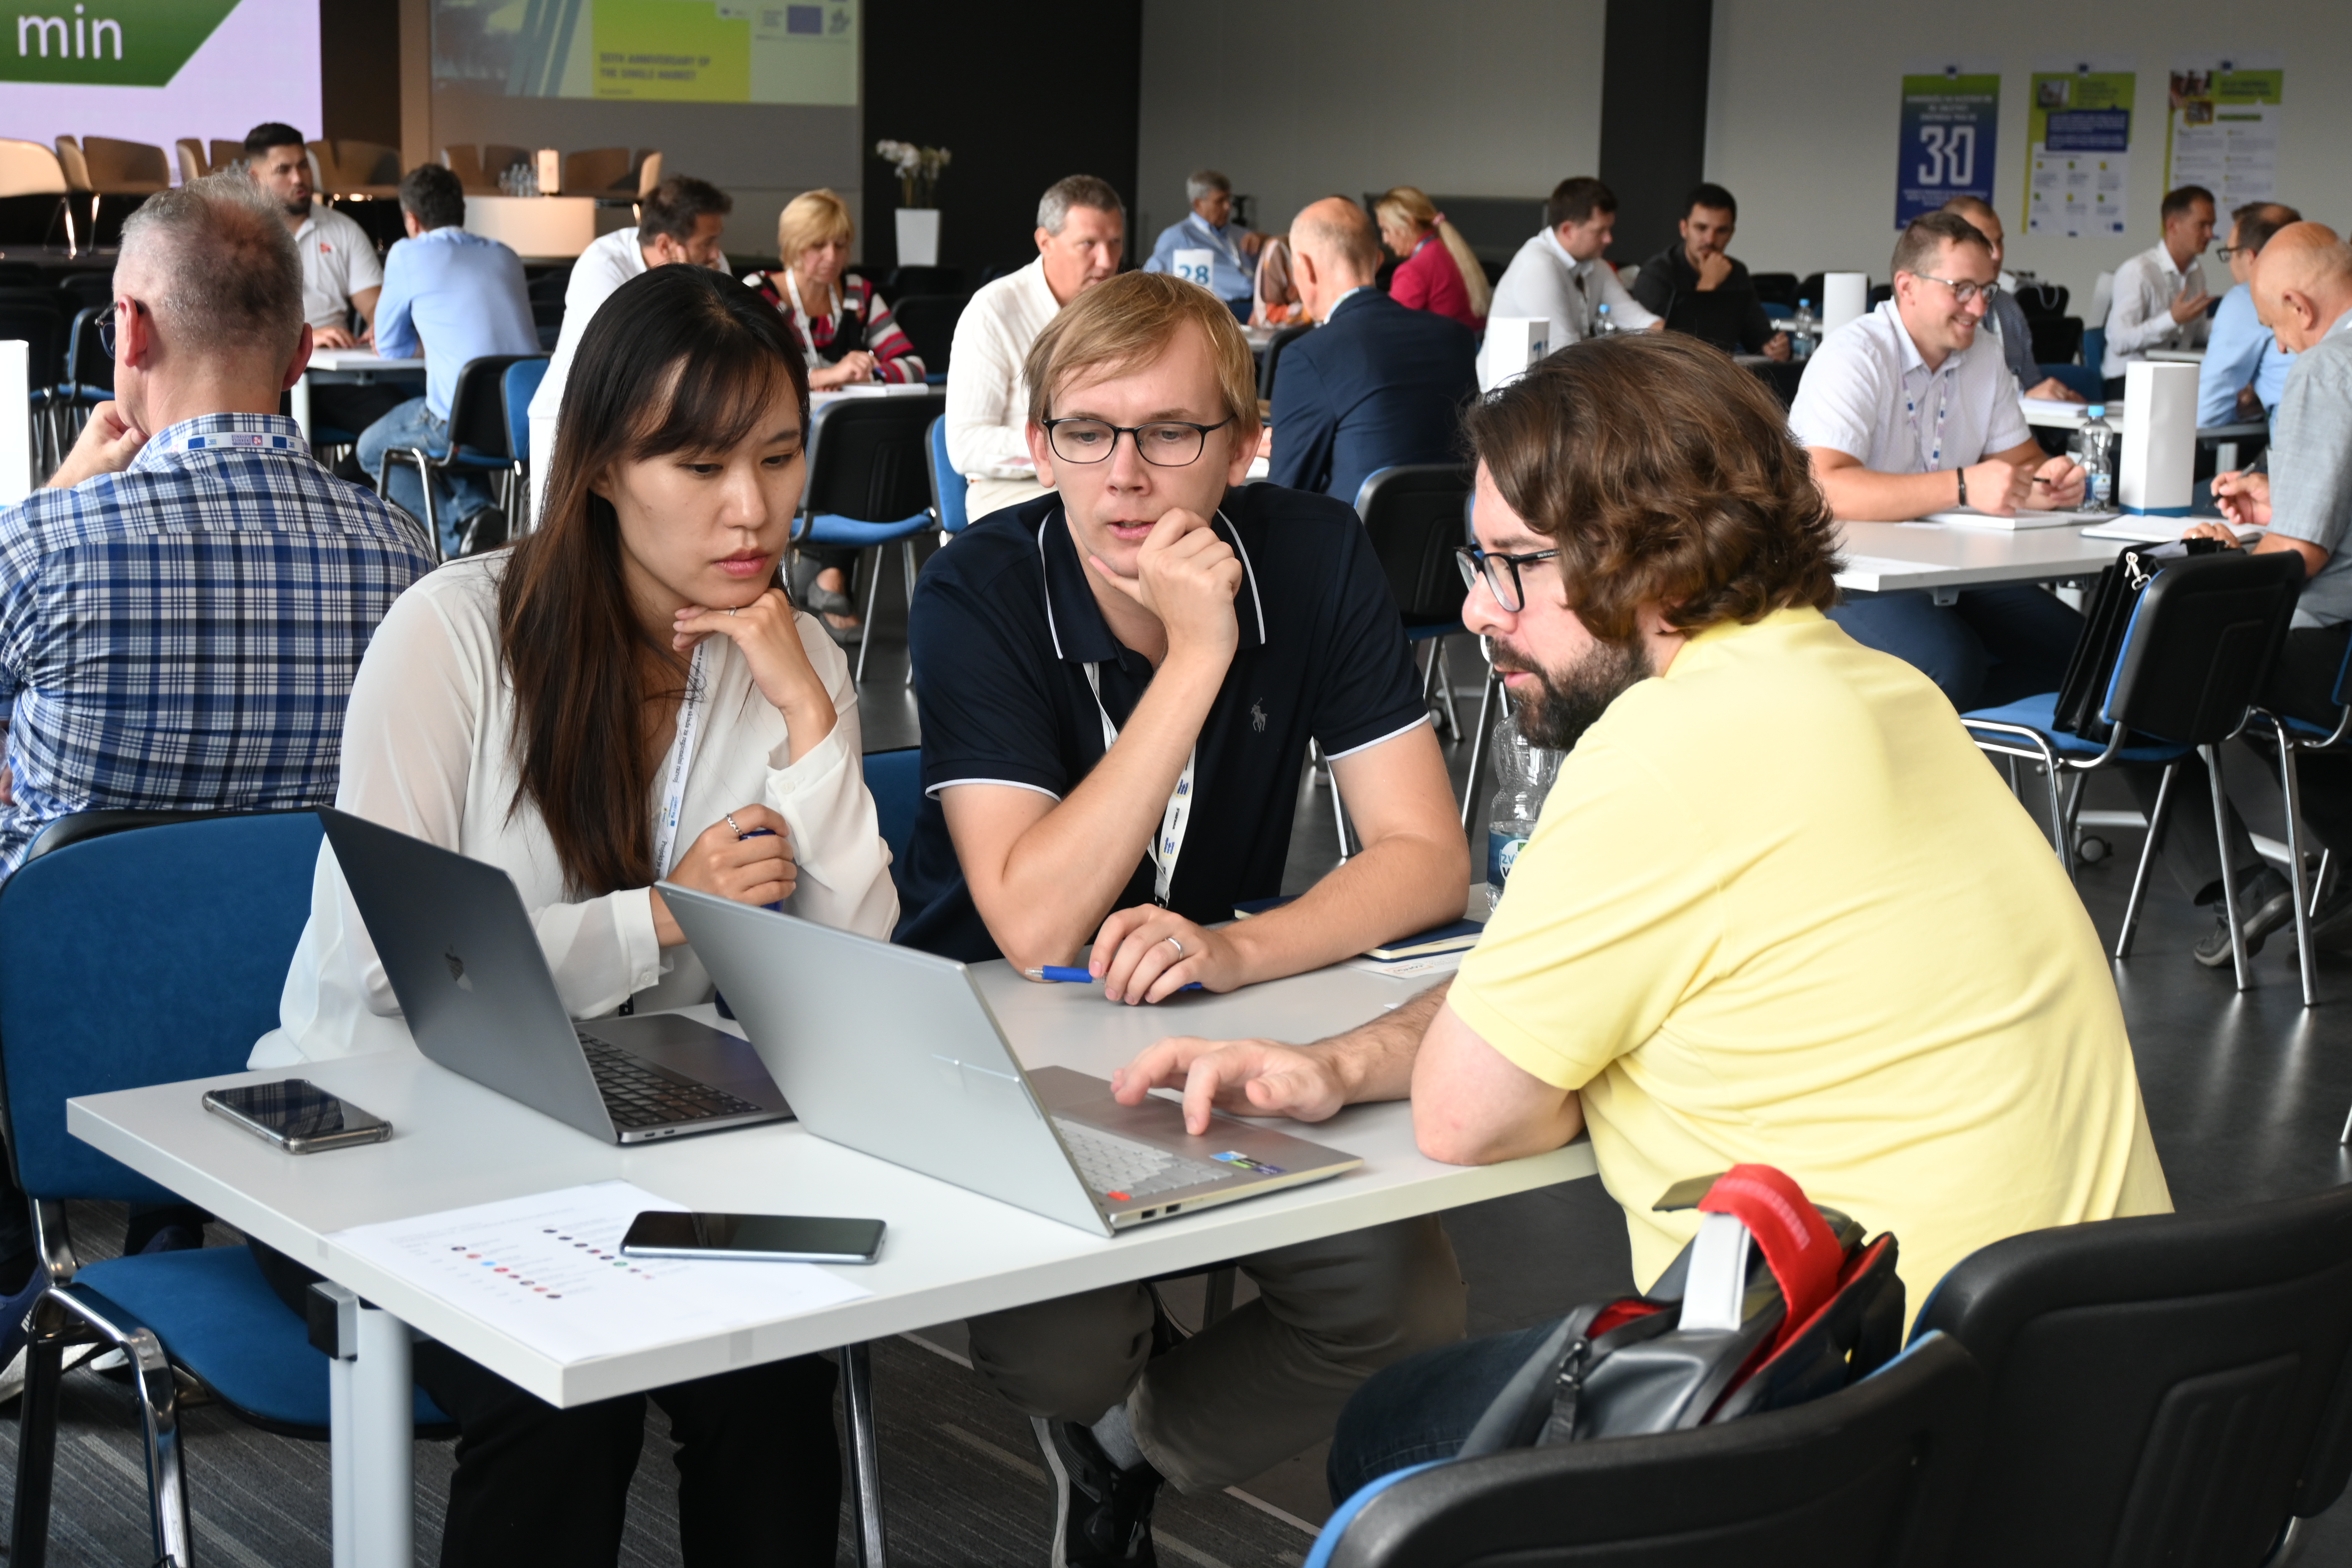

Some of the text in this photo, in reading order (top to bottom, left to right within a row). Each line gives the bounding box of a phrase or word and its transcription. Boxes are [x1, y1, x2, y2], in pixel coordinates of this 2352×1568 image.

[18, 4, 123, 60] min
[1918, 125, 1975, 185] 30
[678, 737, 686, 765] regionalni
[672, 765, 681, 783] razvoj
